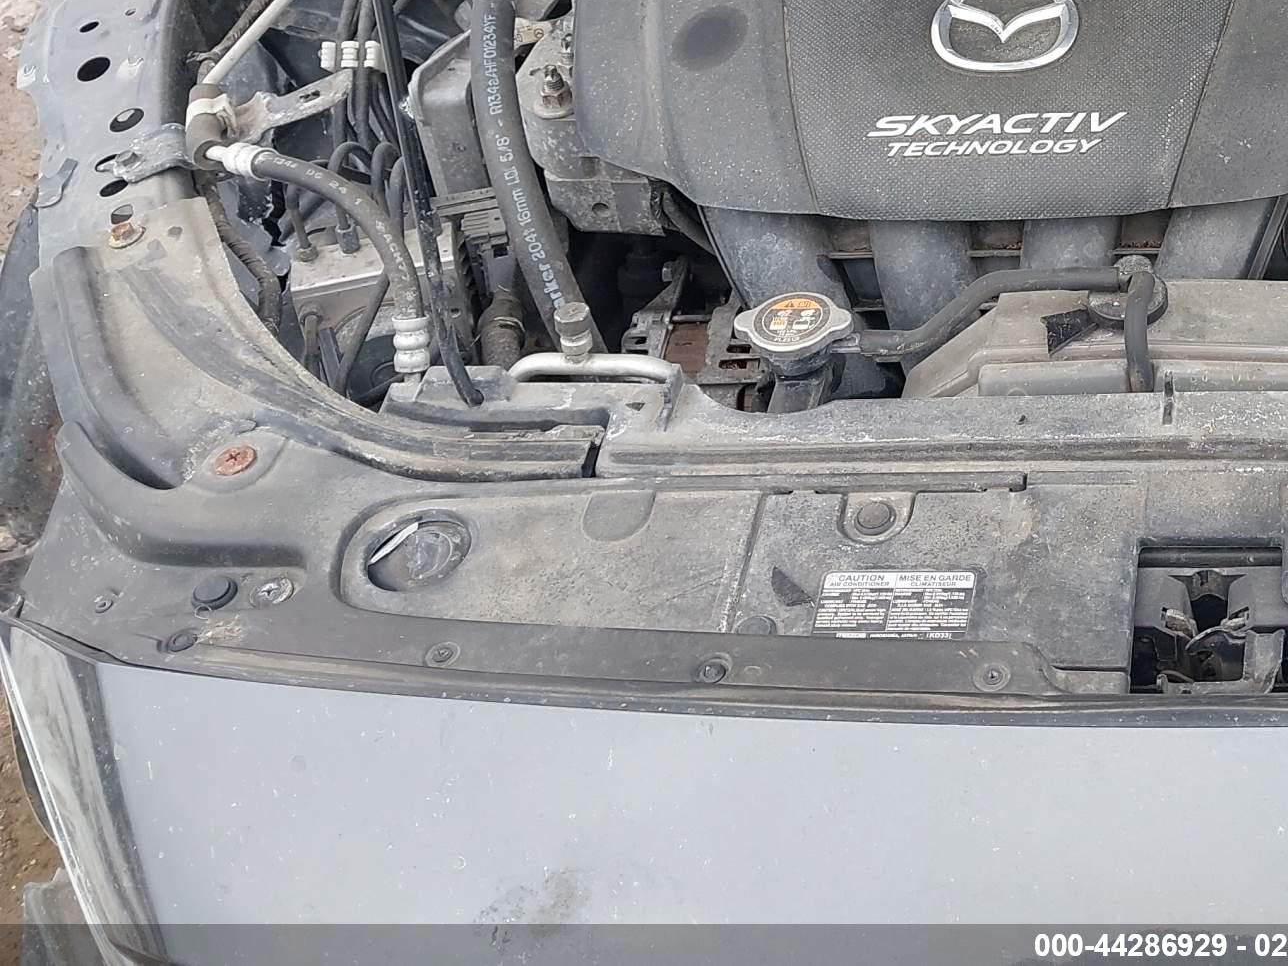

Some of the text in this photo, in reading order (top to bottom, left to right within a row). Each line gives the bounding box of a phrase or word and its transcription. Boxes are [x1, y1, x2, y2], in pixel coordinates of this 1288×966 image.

[866, 111, 1128, 137] SKYACTIV
[887, 138, 1103, 157] TECHNOLOGY
[511, 188, 532, 227] 16mm
[538, 262, 566, 310] arker
[838, 574, 885, 582] CAUTION
[899, 574, 972, 582] MISE EN GARDE
